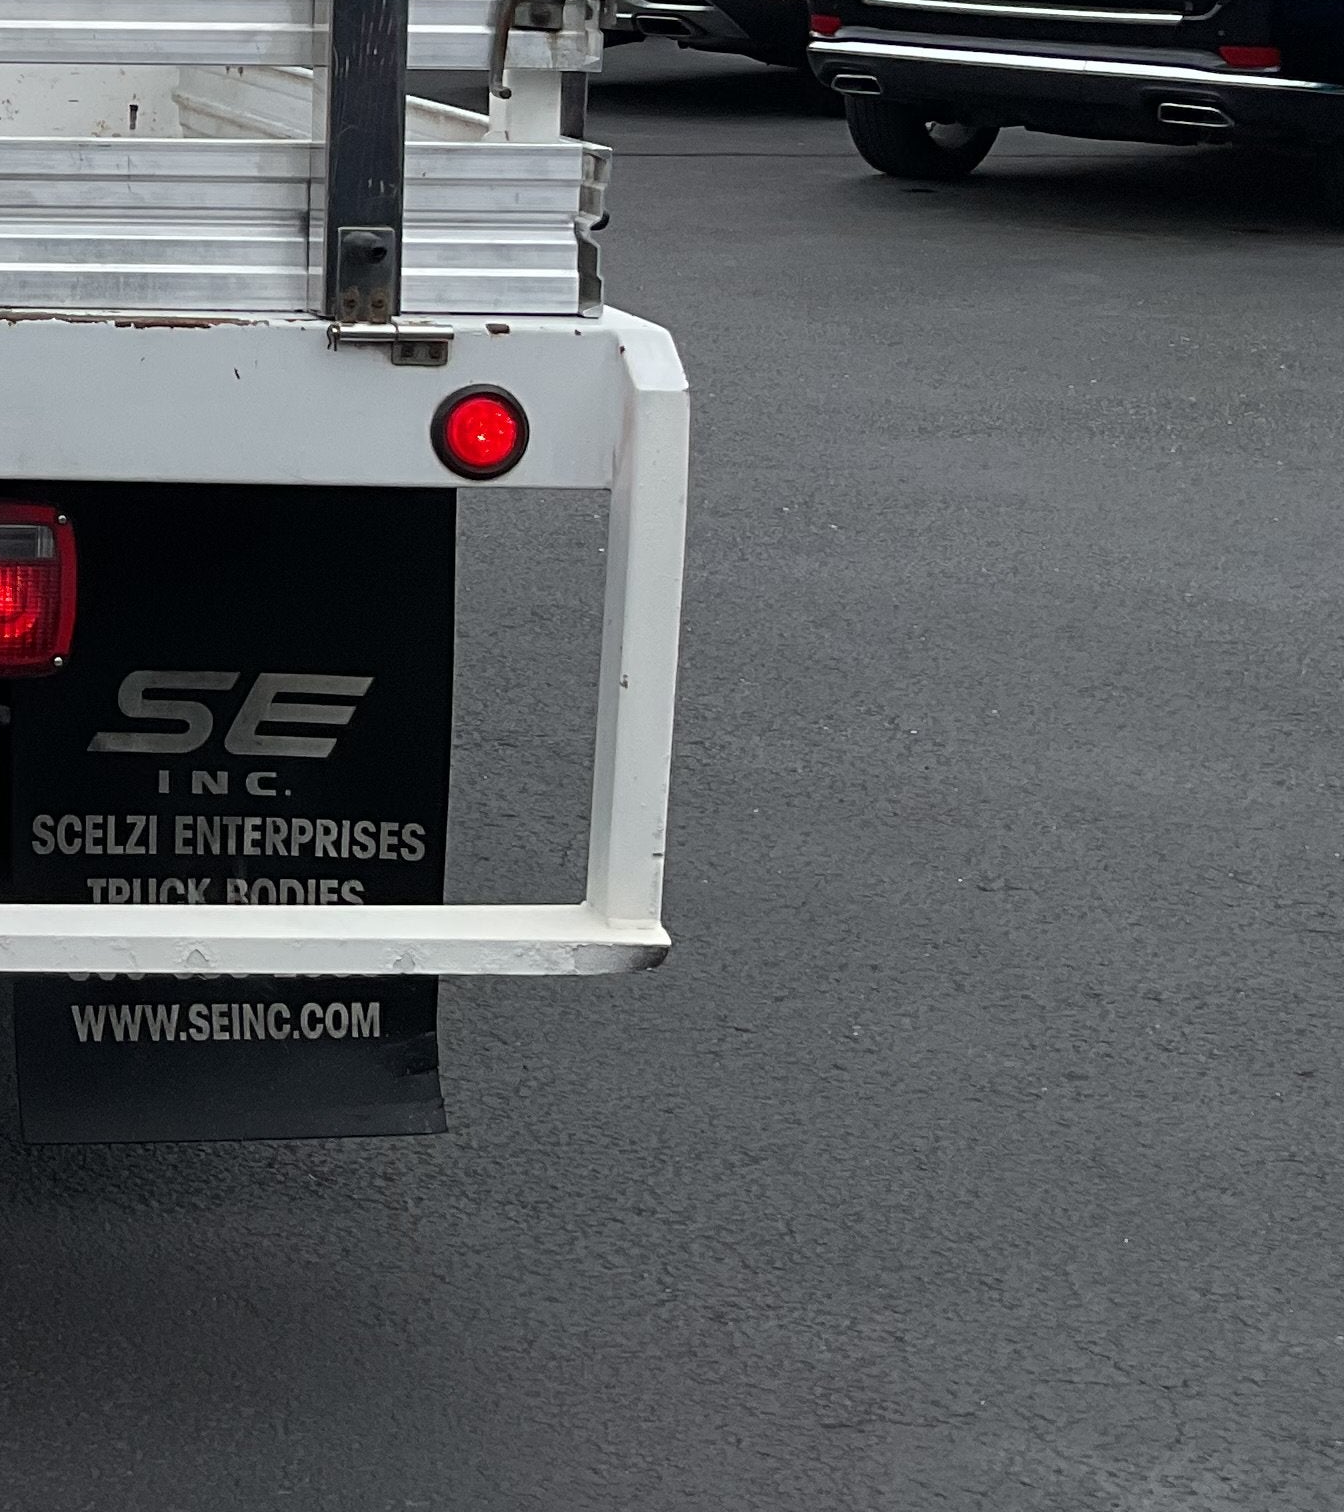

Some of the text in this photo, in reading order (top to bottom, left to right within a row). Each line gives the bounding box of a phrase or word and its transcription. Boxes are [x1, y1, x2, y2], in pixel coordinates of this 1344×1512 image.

[87, 670, 375, 758] SE
[158, 770, 292, 796] INC.
[31, 814, 426, 861] SCELZI ENTERPRISES
[71, 1002, 381, 1042] WWW.SEINC.COM
